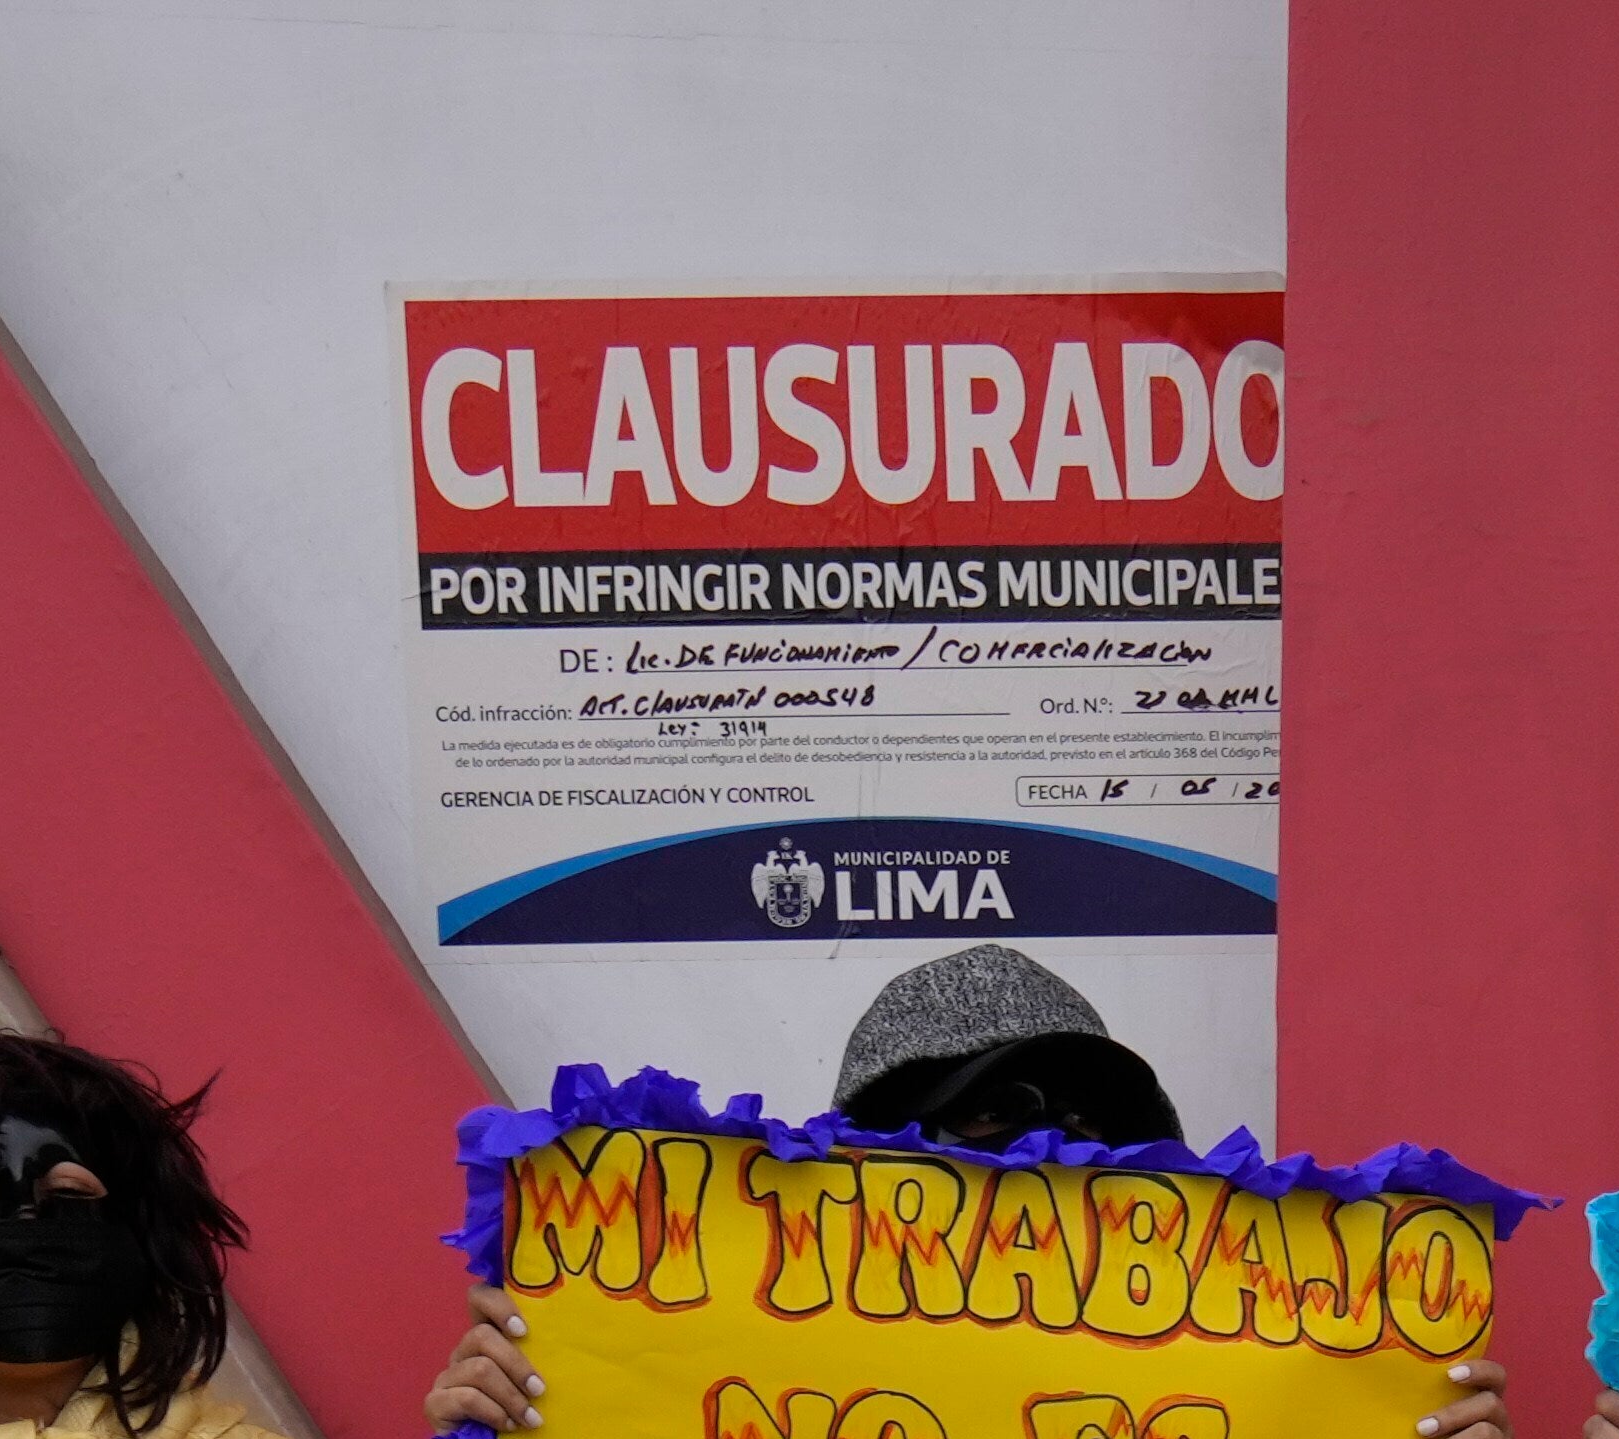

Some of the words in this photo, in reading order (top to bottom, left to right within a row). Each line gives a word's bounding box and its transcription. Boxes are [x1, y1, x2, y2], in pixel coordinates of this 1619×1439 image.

[420, 342, 1284, 510] CLAUSURADO
[430, 566, 526, 615] POR
[538, 563, 770, 613] INFRINGIR
[784, 560, 985, 610] NORMAS
[998, 558, 1282, 607] MUNICIPALE
[436, 706, 475, 722] Cód.
[480, 705, 572, 721] infracción:
[1040, 697, 1079, 714] Ord.
[760, 737, 787, 749] parte
[793, 735, 810, 746] del
[963, 735, 983, 746] que
[987, 734, 1026, 746] operan
[1059, 733, 1110, 745] presente
[1174, 748, 1197, 759] 368
[441, 792, 534, 808] GERENCIA
[538, 791, 563, 806] DE
[568, 785, 705, 806] FISCALIZACIÓN
[710, 787, 721, 802] Y
[727, 786, 815, 802] CONTROL
[1028, 784, 1087, 800] FECHA
[834, 851, 981, 866] MUNICIPALIDAD
[987, 850, 1010, 865] DE
[836, 869, 1015, 921] LIMA
[507, 1127, 714, 1313] MI
[740, 1149, 1496, 1361] TRABAJO
